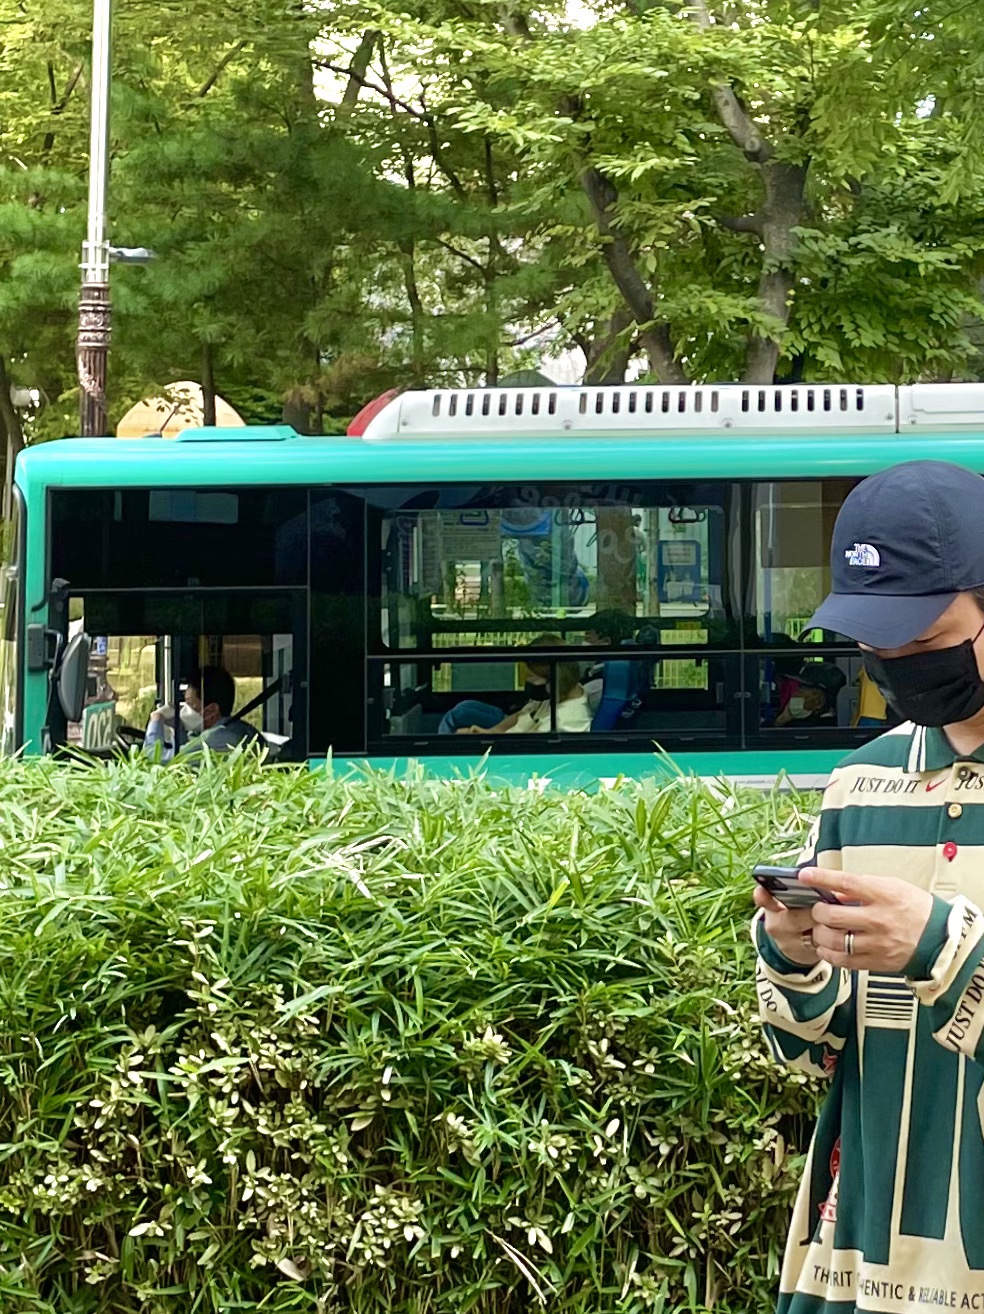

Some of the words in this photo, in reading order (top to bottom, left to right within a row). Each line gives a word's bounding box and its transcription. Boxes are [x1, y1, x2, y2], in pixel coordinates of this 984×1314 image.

[850, 777, 885, 793] JUST
[883, 779, 903, 794] DO
[904, 779, 922, 794] IT
[945, 1001, 977, 1053] JUST
[908, 1287, 915, 1302] &
